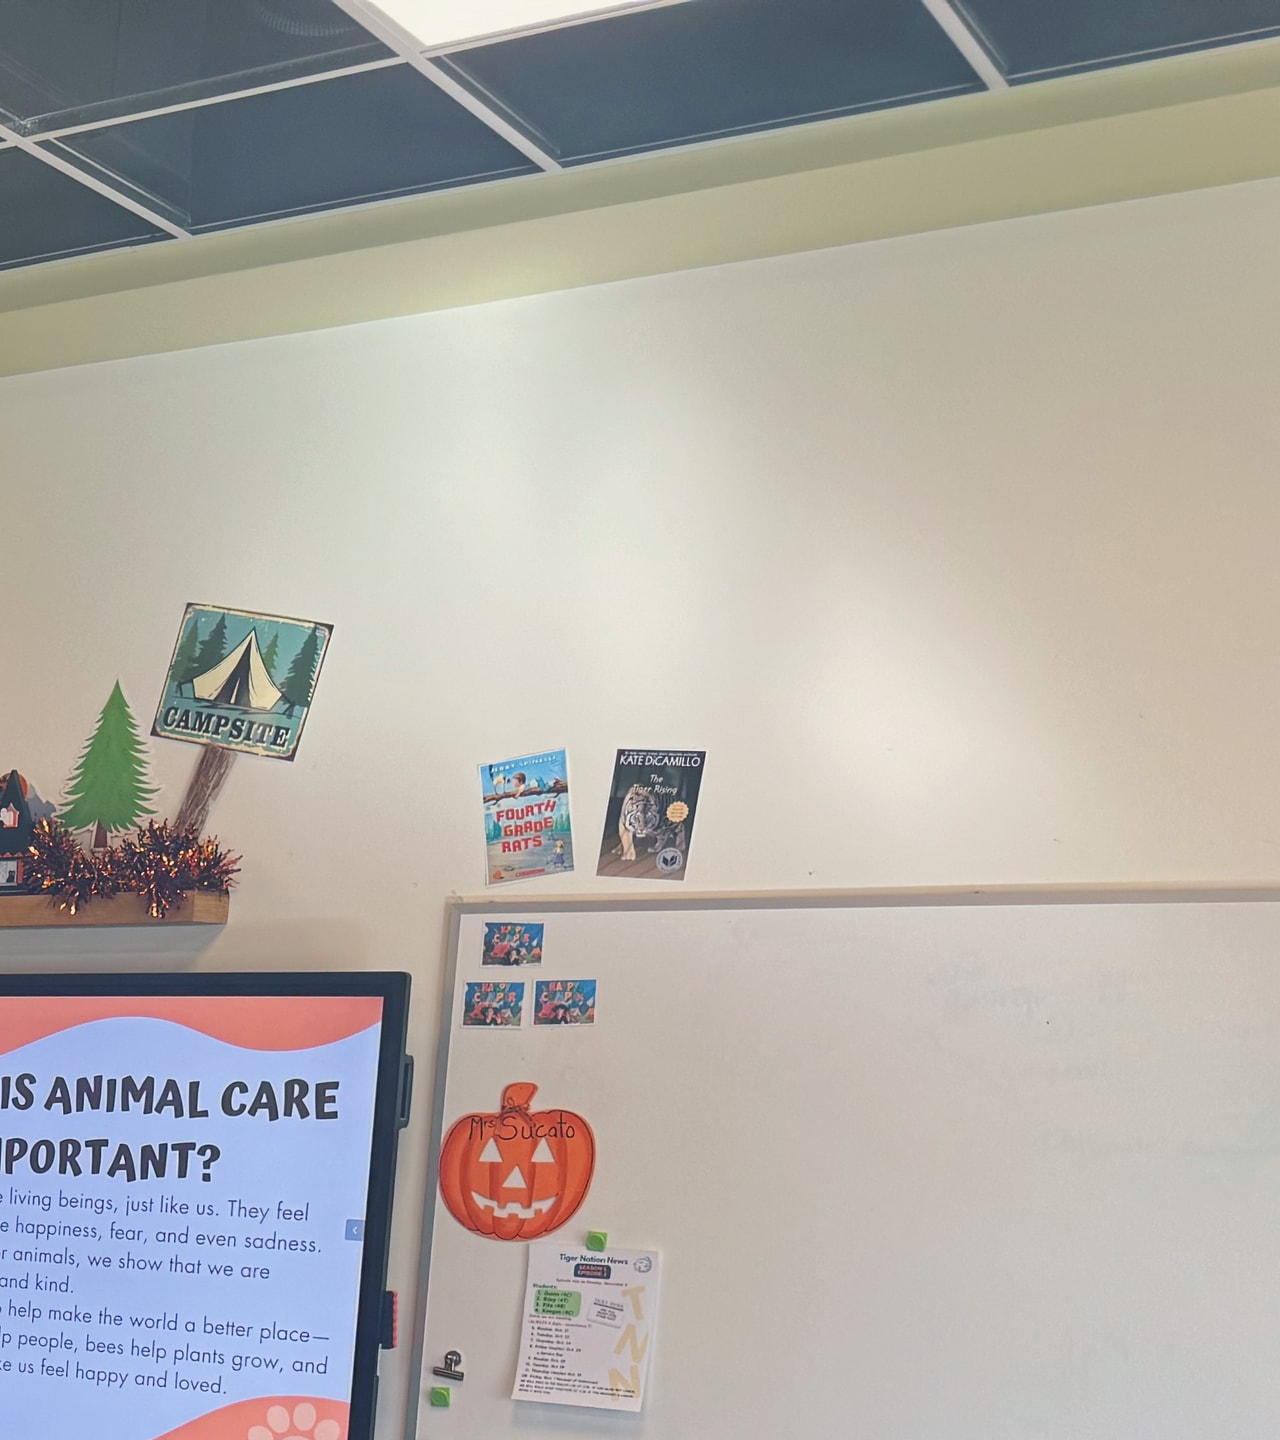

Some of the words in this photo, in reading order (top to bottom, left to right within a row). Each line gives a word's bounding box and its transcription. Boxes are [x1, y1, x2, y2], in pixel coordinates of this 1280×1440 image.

[162, 705, 292, 749] CAMPSITE
[620, 755, 644, 766] KATE
[653, 784, 678, 796] Rising
[495, 799, 557, 823] FOURTH
[503, 816, 554, 838] GRADE
[501, 835, 543, 854] RATS
[1, 1073, 36, 1110] IS
[44, 1075, 209, 1119] ANIMAL
[221, 1079, 340, 1122] CARE
[469, 1116, 495, 1141] Mrs
[494, 1111, 576, 1141] Sucato
[10, 1187, 51, 1211] living
[59, 1189, 117, 1214] beings,
[126, 1196, 154, 1216] just
[160, 1195, 189, 1214] like
[197, 1204, 219, 1216] us.
[228, 1199, 270, 1224] They
[277, 1201, 309, 1221] feel
[16, 1215, 101, 1241] happiness,
[111, 1221, 147, 1244] fear,
[156, 1226, 189, 1244] and
[196, 1234, 236, 1247] even
[244, 1231, 321, 1252] sadness.
[13, 1247, 79, 1268] animals,
[88, 1256, 111, 1267] we
[119, 1252, 163, 1271] show
[170, 1254, 201, 1274] that
[208, 1264, 233, 1276] we
[241, 1267, 270, 1279] are
[559, 1253, 579, 1264] Tiger
[580, 1255, 605, 1265] Nation
[607, 1257, 628, 1266] News
[0, 1272, 29, 1289] and
[35, 1273, 73, 1293] kind.
[9, 1299, 41, 1323] help
[49, 1305, 91, 1323] make
[99, 1307, 123, 1326] the
[130, 1312, 178, 1330] world
[185, 1321, 195, 1332] a
[204, 1315, 253, 1337] better
[260, 1321, 329, 1344] place—
[18, 1332, 77, 1353] people,
[86, 1334, 123, 1354] bees
[131, 1338, 166, 1364] help
[174, 1343, 224, 1365] plants
[232, 1355, 283, 1373] grow,
[292, 1356, 328, 1374] and
[19, 1362, 34, 1374] us
[41, 1358, 69, 1377] feel
[76, 1361, 128, 1388] happy
[135, 1370, 167, 1387] and
[175, 1371, 226, 1394] loved.
